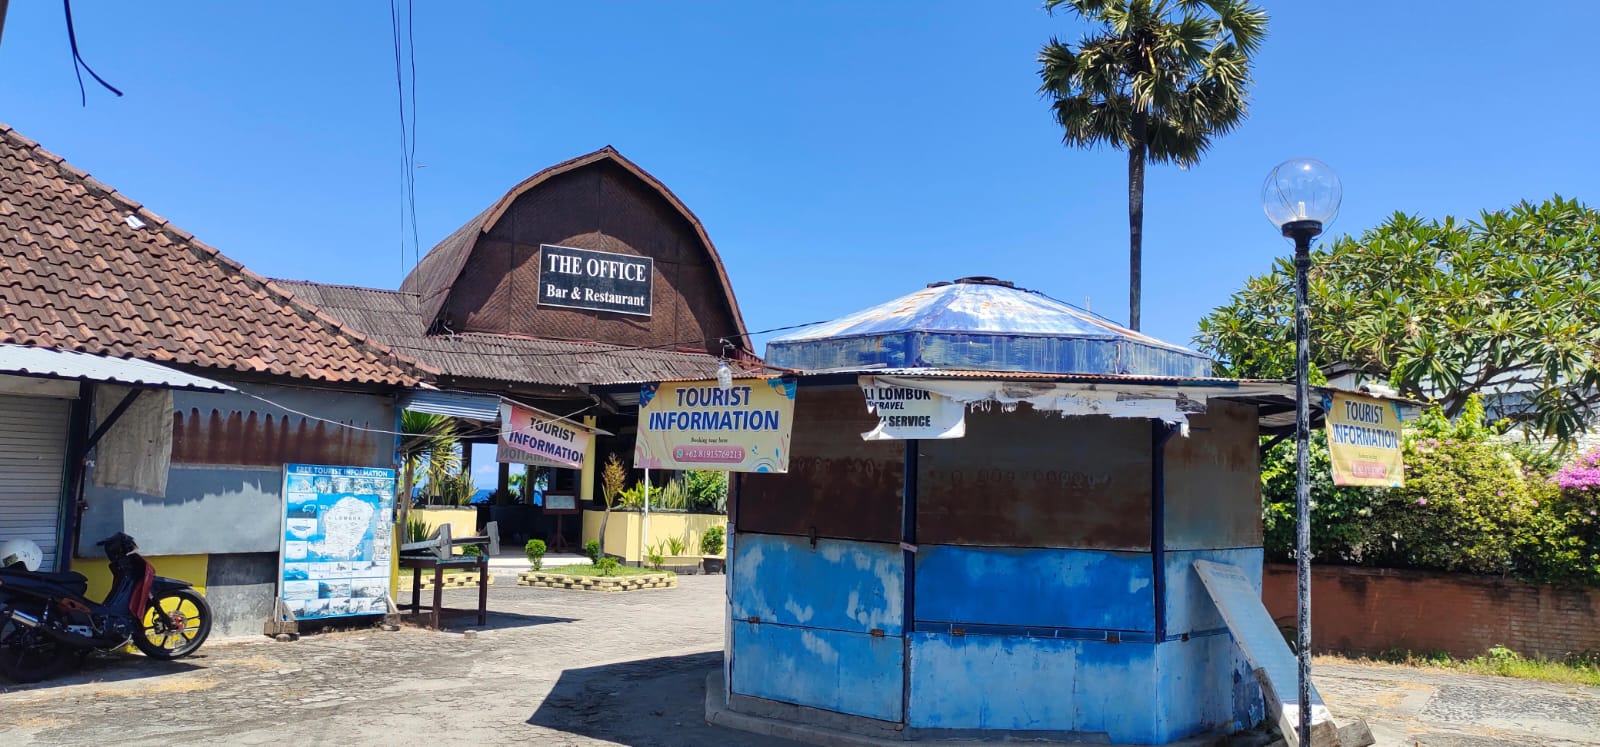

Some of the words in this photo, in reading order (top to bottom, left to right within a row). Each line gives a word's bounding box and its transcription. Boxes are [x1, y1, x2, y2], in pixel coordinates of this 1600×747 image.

[548, 254, 582, 275] THE
[586, 258, 646, 282] OFFICE
[546, 284, 568, 298] Bar
[570, 286, 581, 300] &
[584, 287, 645, 307] Restaurant
[675, 386, 752, 407] TOURIST
[649, 410, 779, 431] INFORMATION
[888, 415, 931, 427] SERVICE
[1345, 400, 1384, 424] TOURIST
[530, 417, 576, 443] TOURIST
[690, 436, 708, 444] Booking
[1332, 424, 1398, 448] INFORMATION
[509, 431, 585, 465] INFORMATION
[296, 466, 312, 474] FREE
[314, 467, 342, 475] TOURIST
[343, 468, 388, 478] INFORMATION
